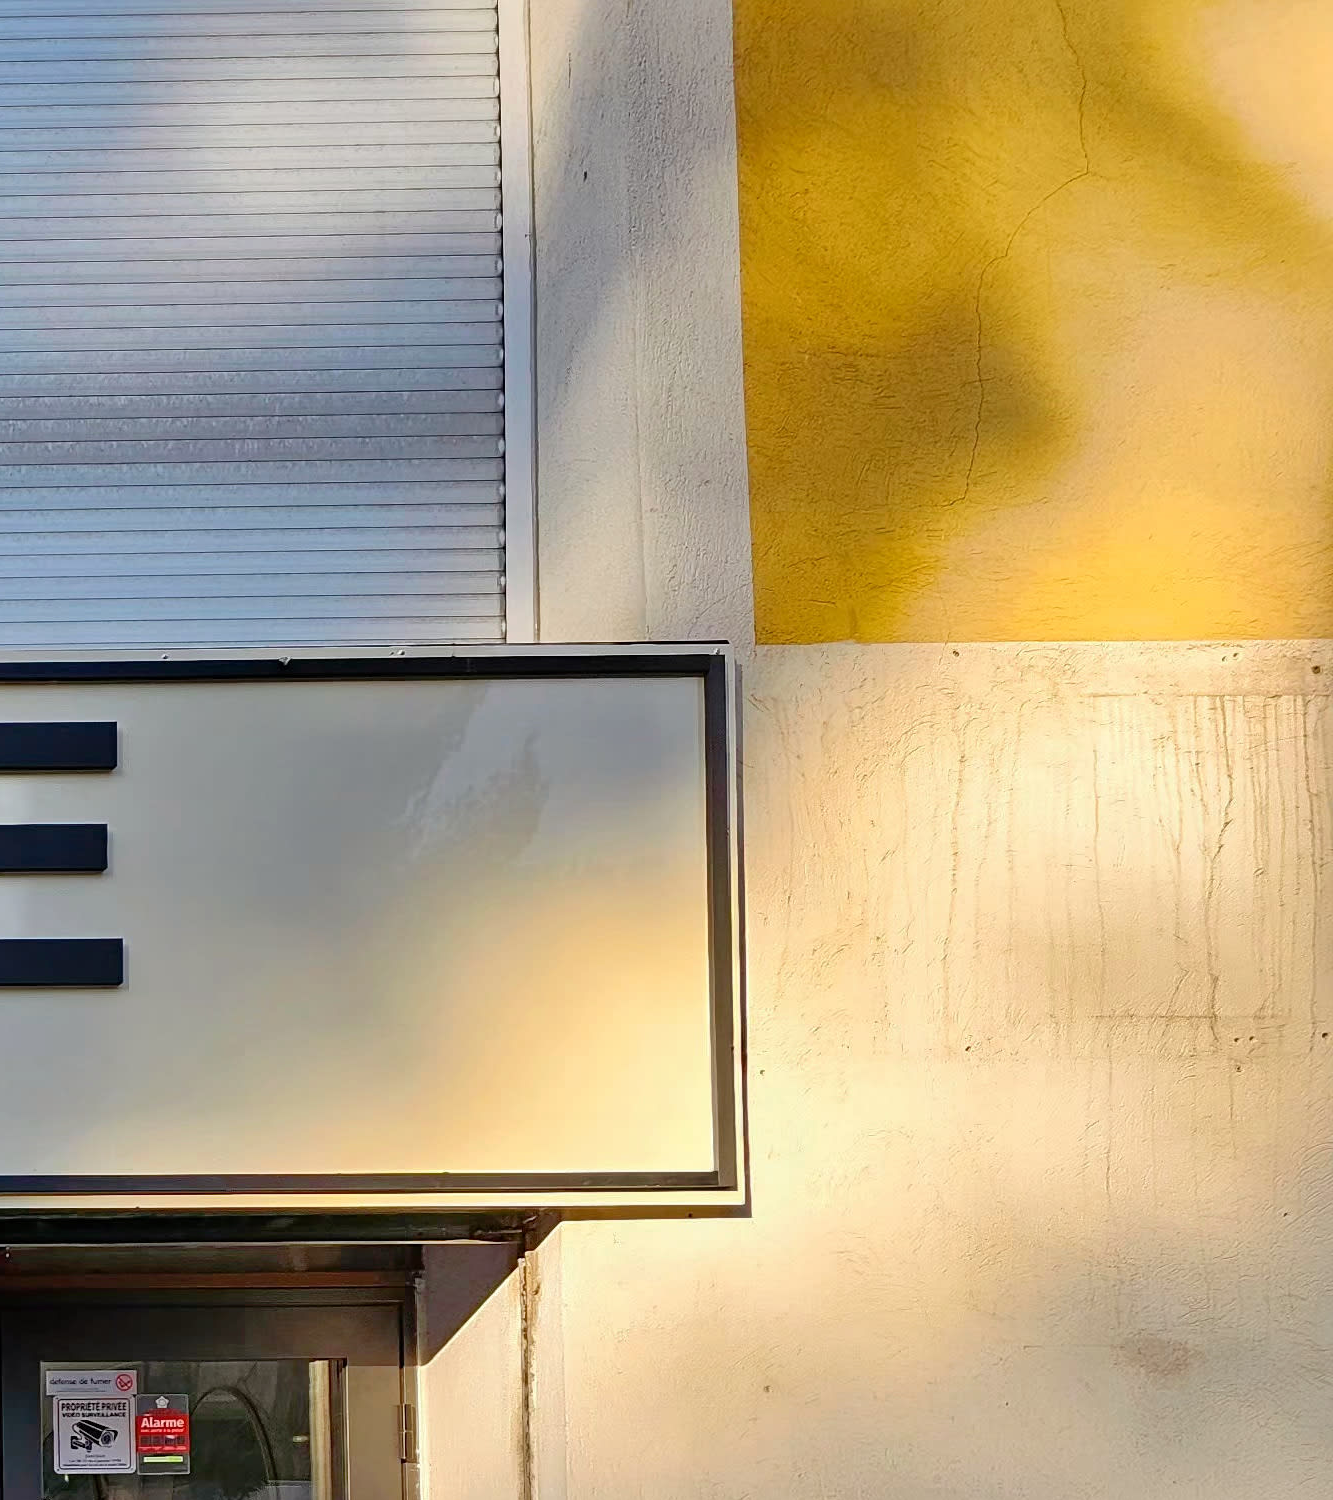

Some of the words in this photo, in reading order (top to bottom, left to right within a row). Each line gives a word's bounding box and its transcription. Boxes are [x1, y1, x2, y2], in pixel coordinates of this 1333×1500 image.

[60, 1401, 101, 1412] PROPRIÉTÉ
[100, 1401, 127, 1411] PRIVÉE
[140, 1414, 185, 1428] Alarme
